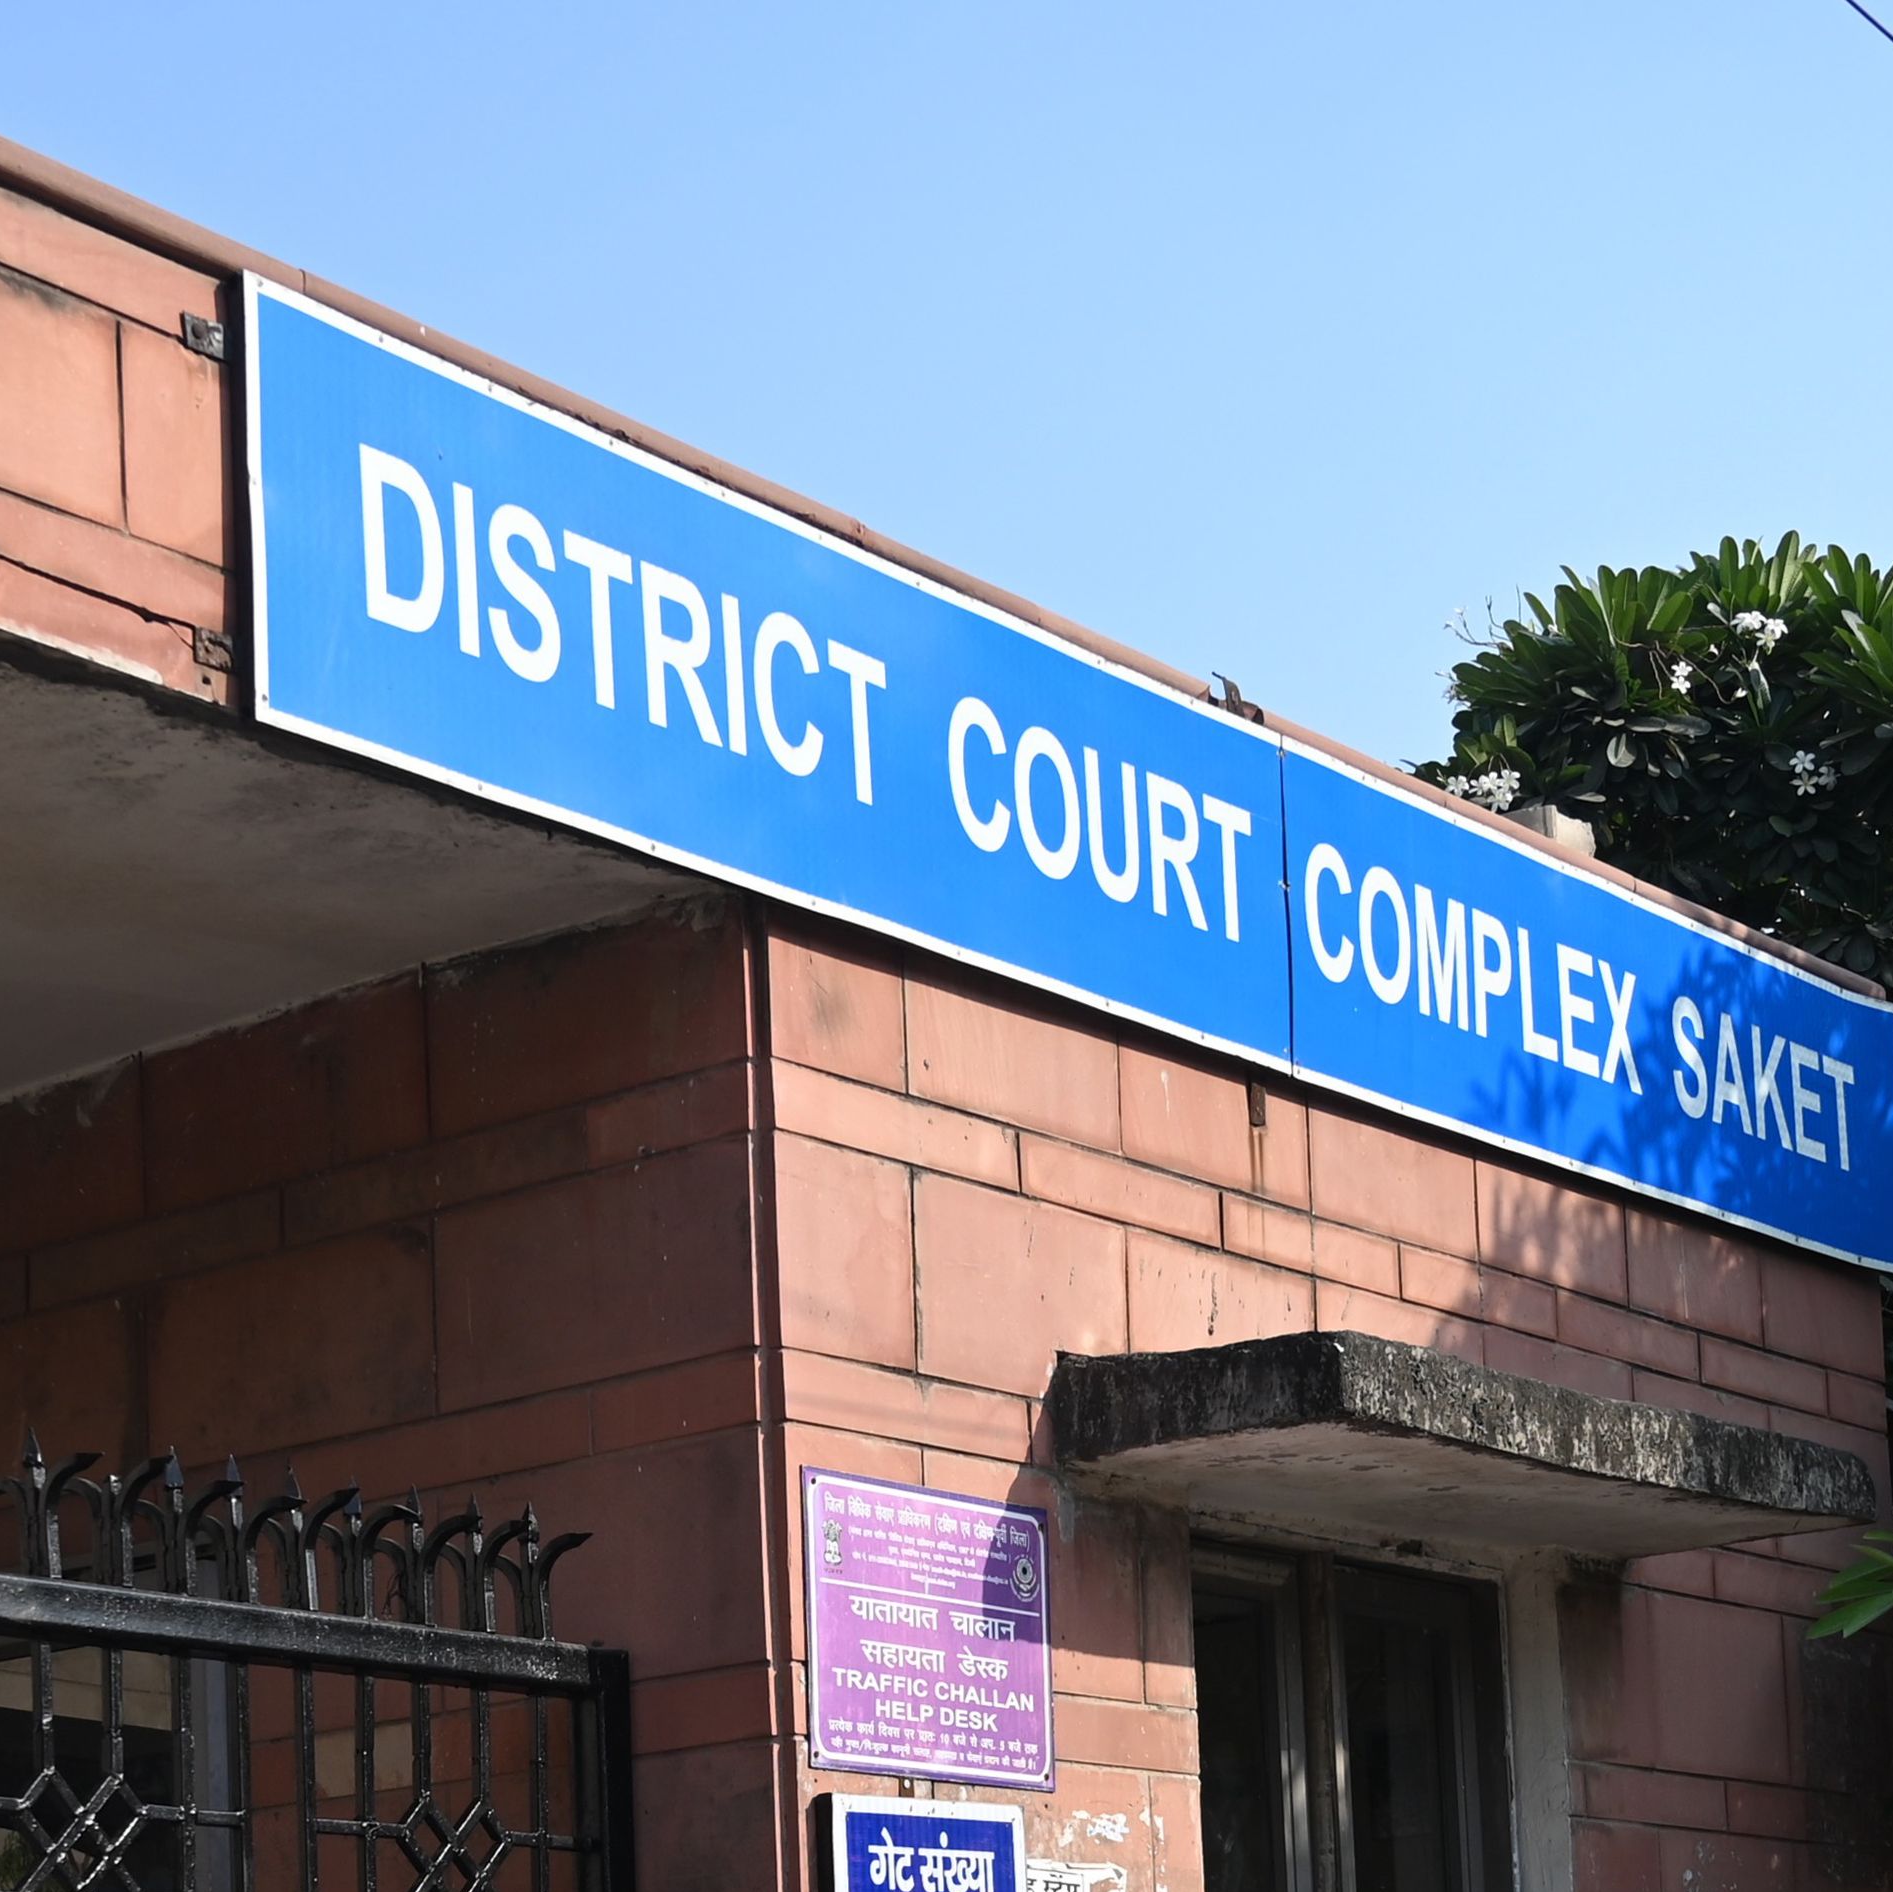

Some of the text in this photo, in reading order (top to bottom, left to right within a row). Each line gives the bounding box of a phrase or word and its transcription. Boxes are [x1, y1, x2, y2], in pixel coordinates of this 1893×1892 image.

[359, 443, 1855, 1173] DISTRICT COURT COMPLEX SAKET
[824, 1491, 845, 1514] जिला
[848, 1595, 1016, 1643] यातायात चालान
[860, 1639, 1009, 1681] सहायता डेस्क
[831, 1667, 1035, 1712] TRAFFIC CHALLAN
[875, 1699, 999, 1732] HELP DESK
[940, 1732, 949, 1745] 10
